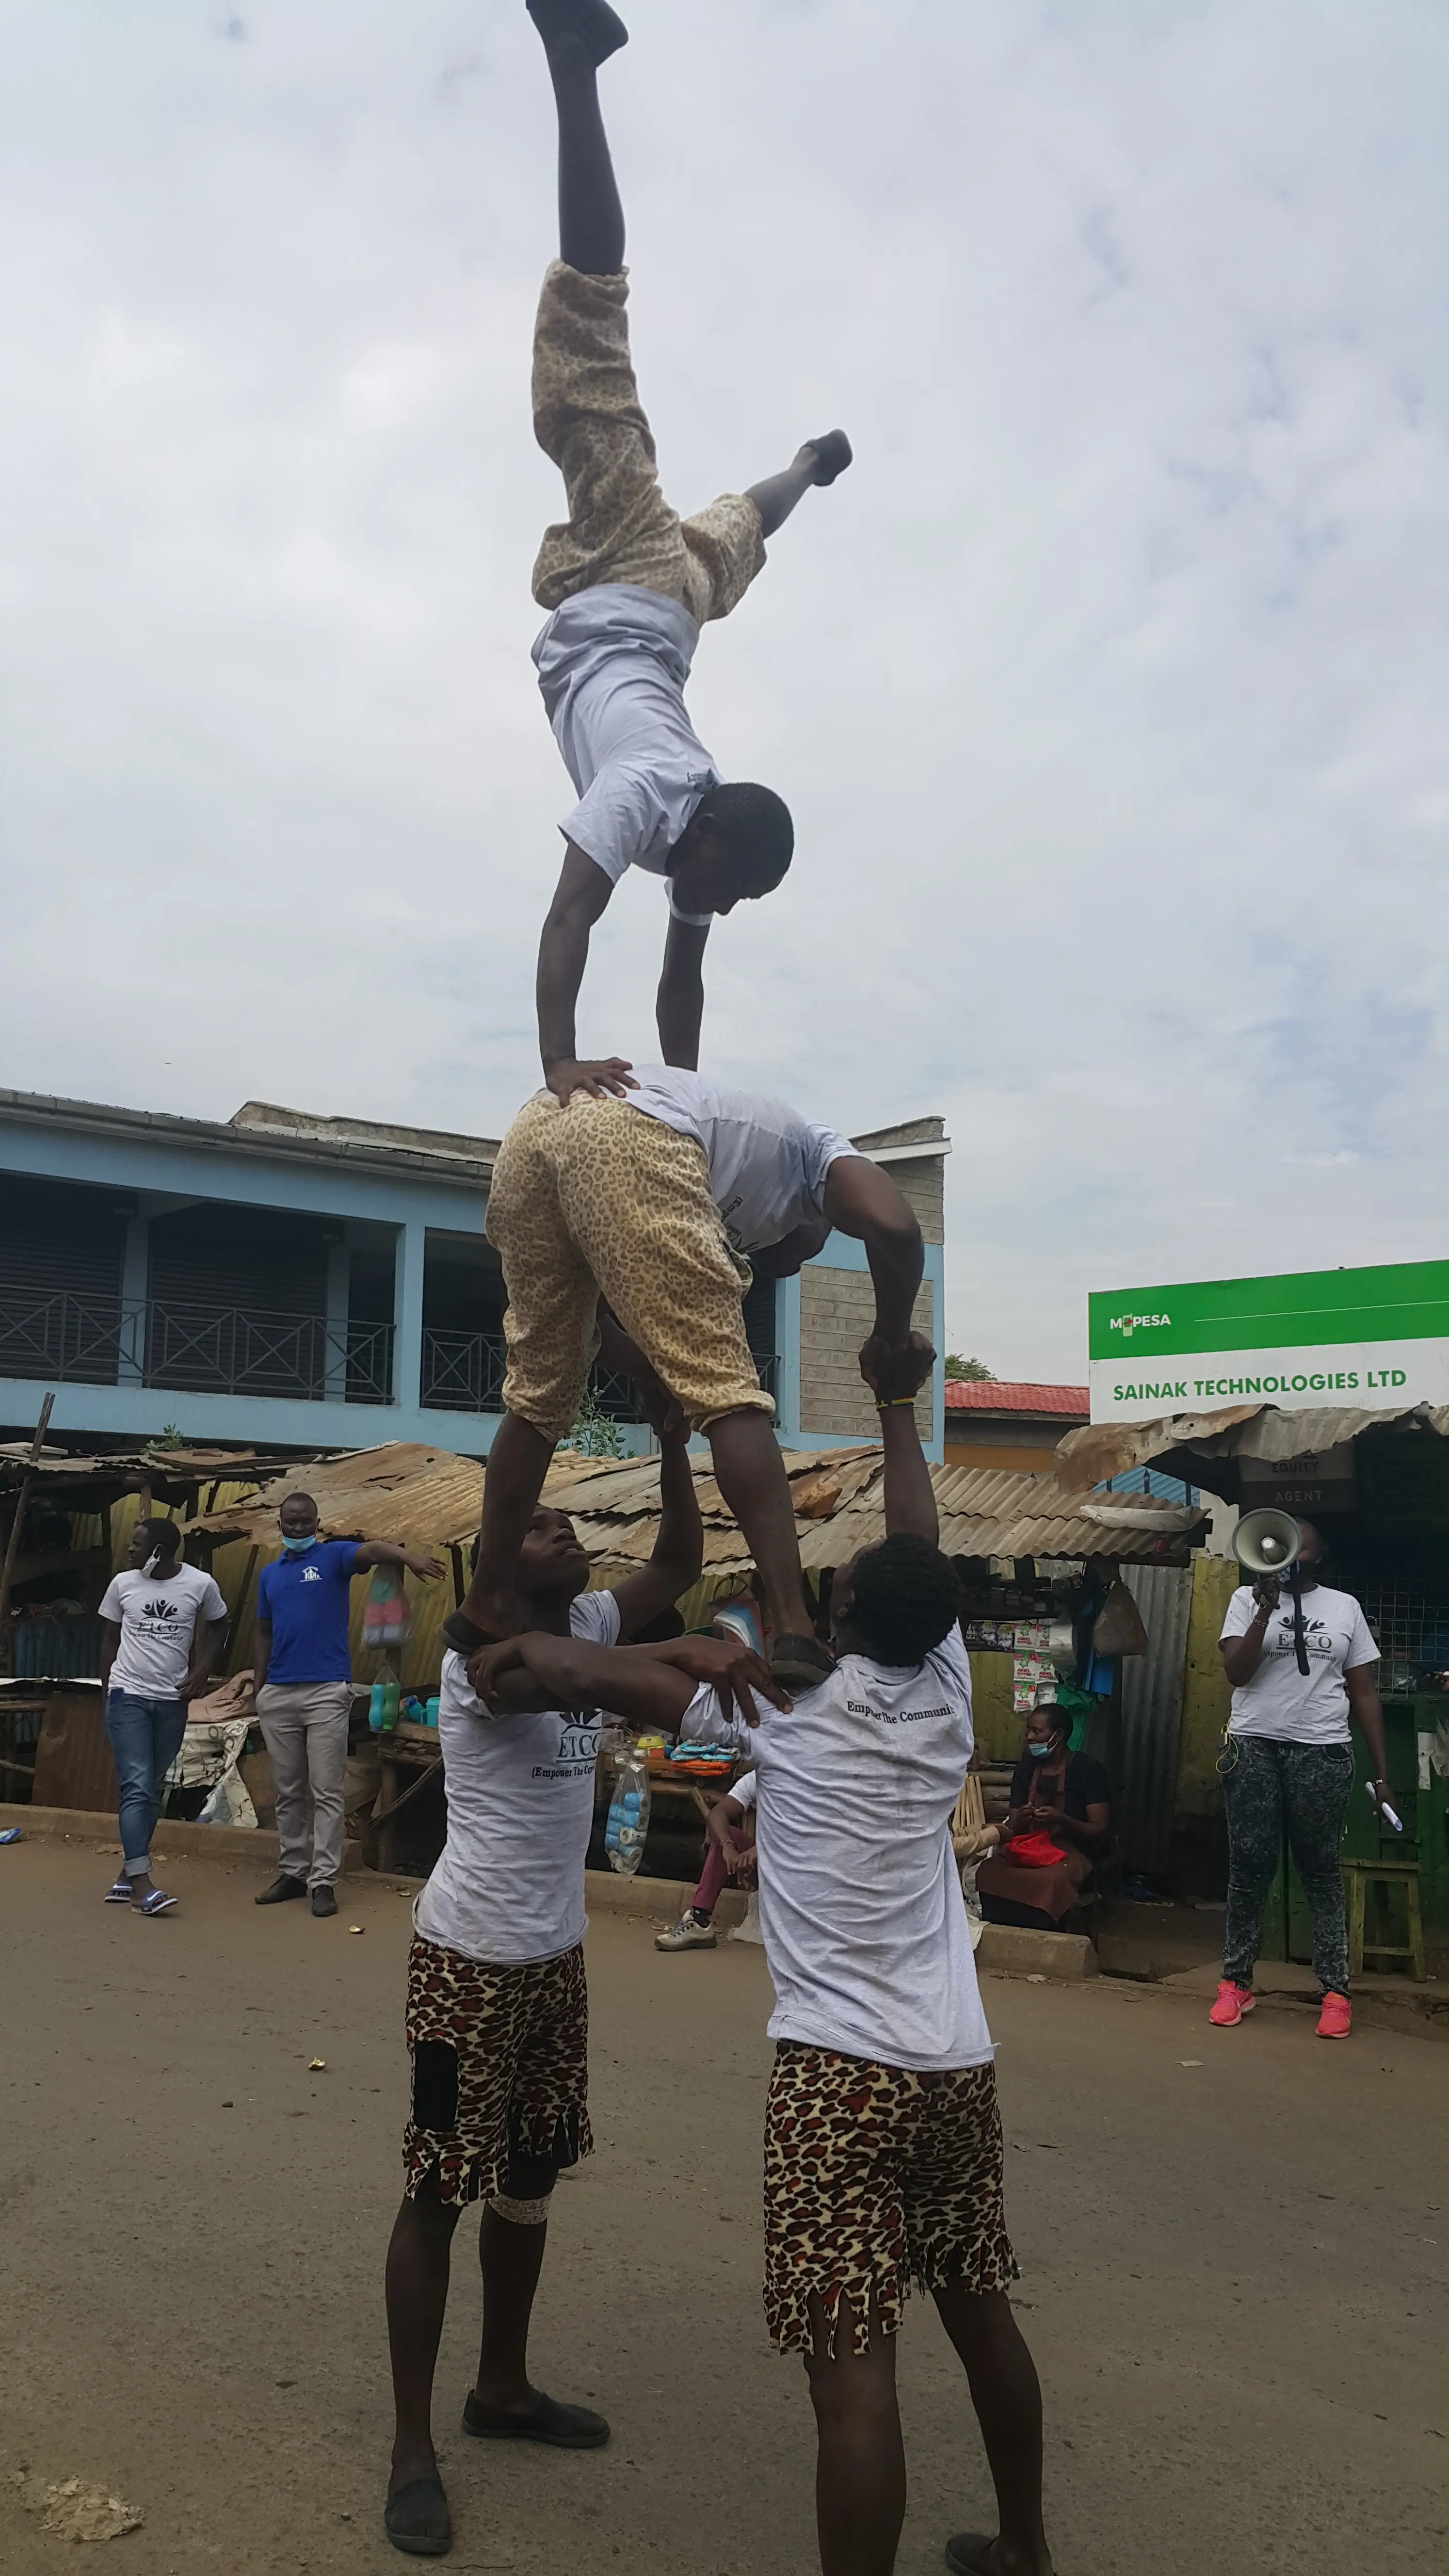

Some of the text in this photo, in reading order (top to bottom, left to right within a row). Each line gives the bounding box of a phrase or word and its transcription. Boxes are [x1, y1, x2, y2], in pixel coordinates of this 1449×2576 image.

[1113, 1370, 1407, 1401] SAINAK TECHNOLOGIES LTD
[1272, 1461, 1320, 1473] EQUITY
[1275, 1490, 1322, 1502] AGENT
[1278, 1634, 1332, 1649] ECO
[882, 1712, 898, 1723] The
[532, 1766, 572, 1780] (Empower
[573, 1766, 583, 1776] The
